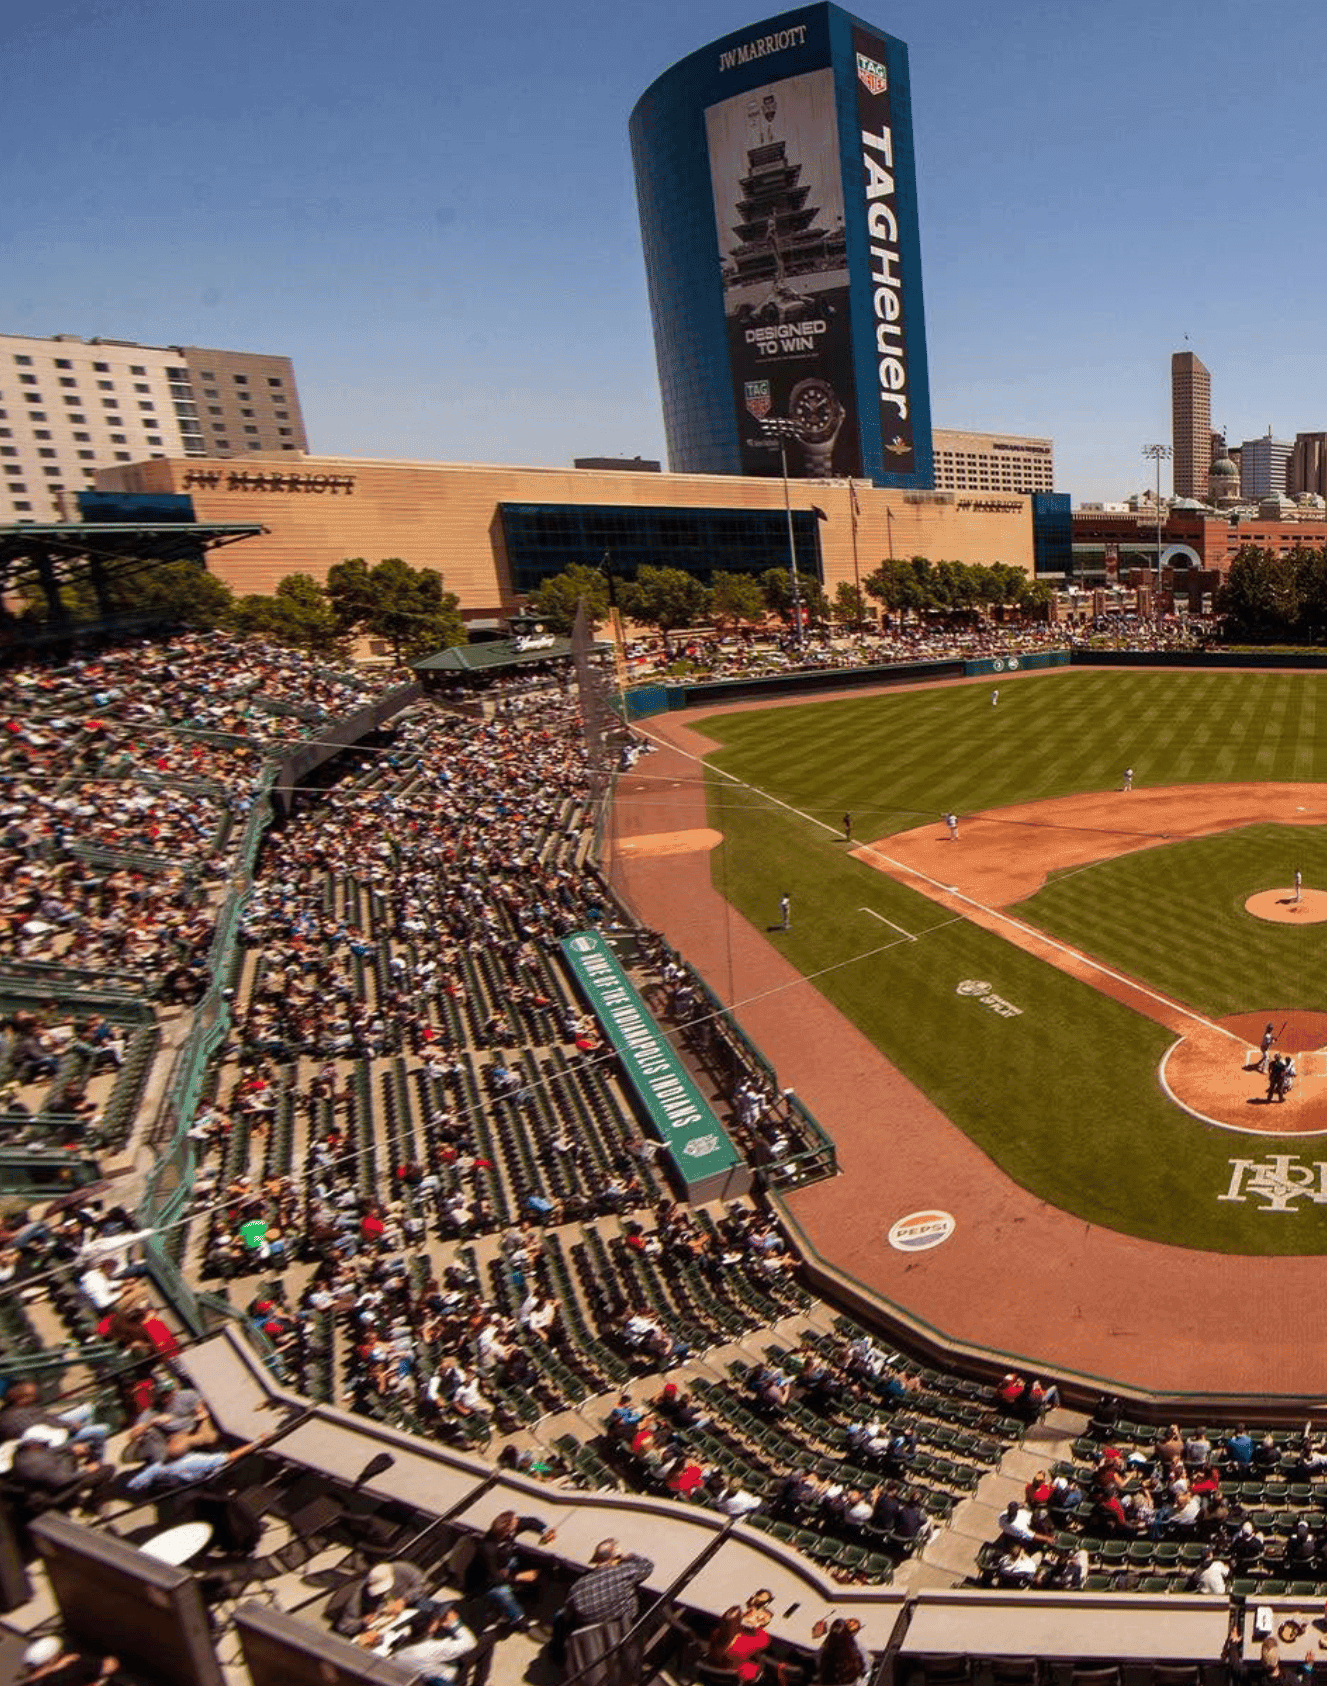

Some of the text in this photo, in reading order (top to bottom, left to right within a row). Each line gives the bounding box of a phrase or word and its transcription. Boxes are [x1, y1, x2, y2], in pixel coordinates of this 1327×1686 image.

[719, 24, 807, 72] JW MARRIOTT
[860, 57, 885, 78] TAG
[745, 319, 827, 344] DESIGNED
[756, 336, 814, 355] TO WIN
[746, 382, 768, 397] TAG
[182, 469, 357, 495] JW MARRIOTT
[581, 953, 613, 977] HOME
[593, 975, 620, 988] OF
[600, 987, 631, 1007] THE
[610, 1004, 671, 1076] INDIANAPOLIS
[648, 1072, 702, 1128] INDIANS
[896, 1222, 947, 1237] PEPSI
